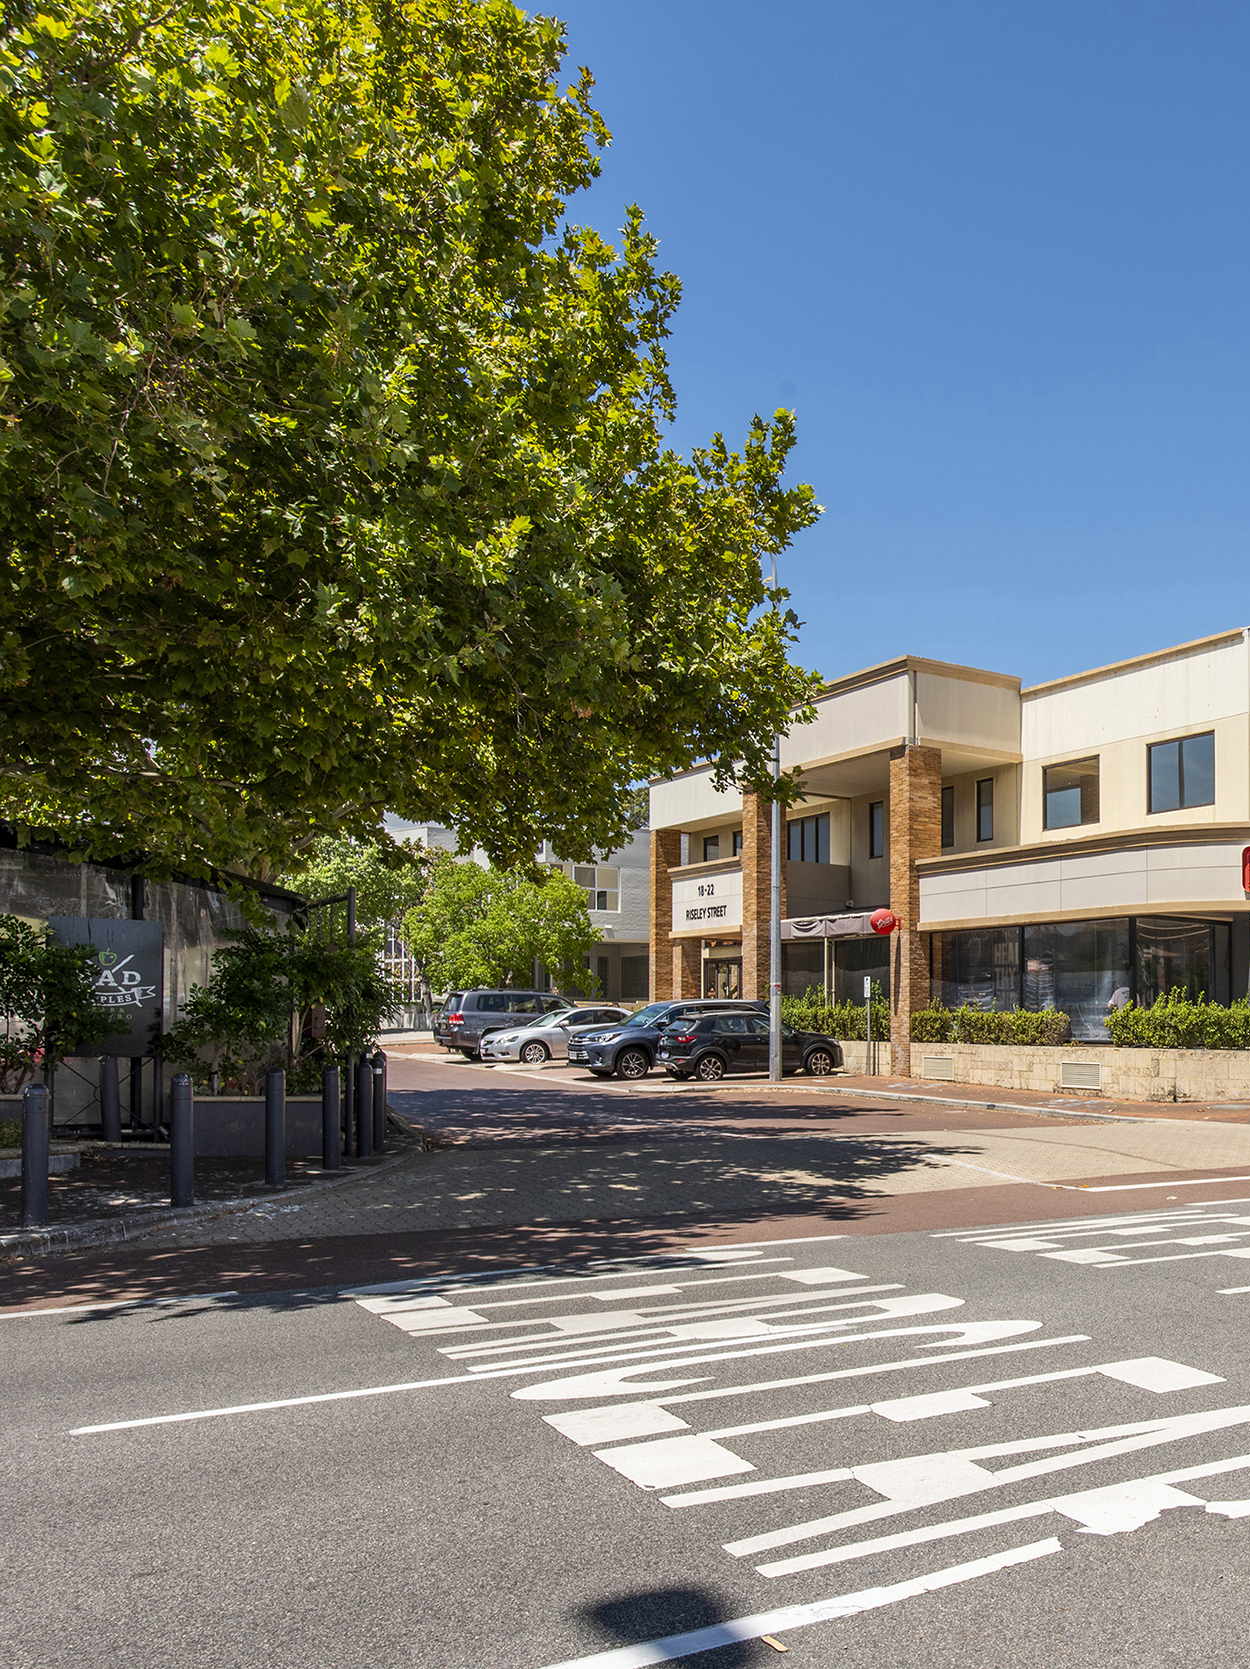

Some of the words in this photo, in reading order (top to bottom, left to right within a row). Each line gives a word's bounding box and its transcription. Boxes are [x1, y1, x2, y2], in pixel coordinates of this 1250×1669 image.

[698, 884, 714, 897] 18-22
[686, 907, 706, 921] RISELEY
[707, 905, 727, 918] STREET
[86, 969, 142, 986] AD
